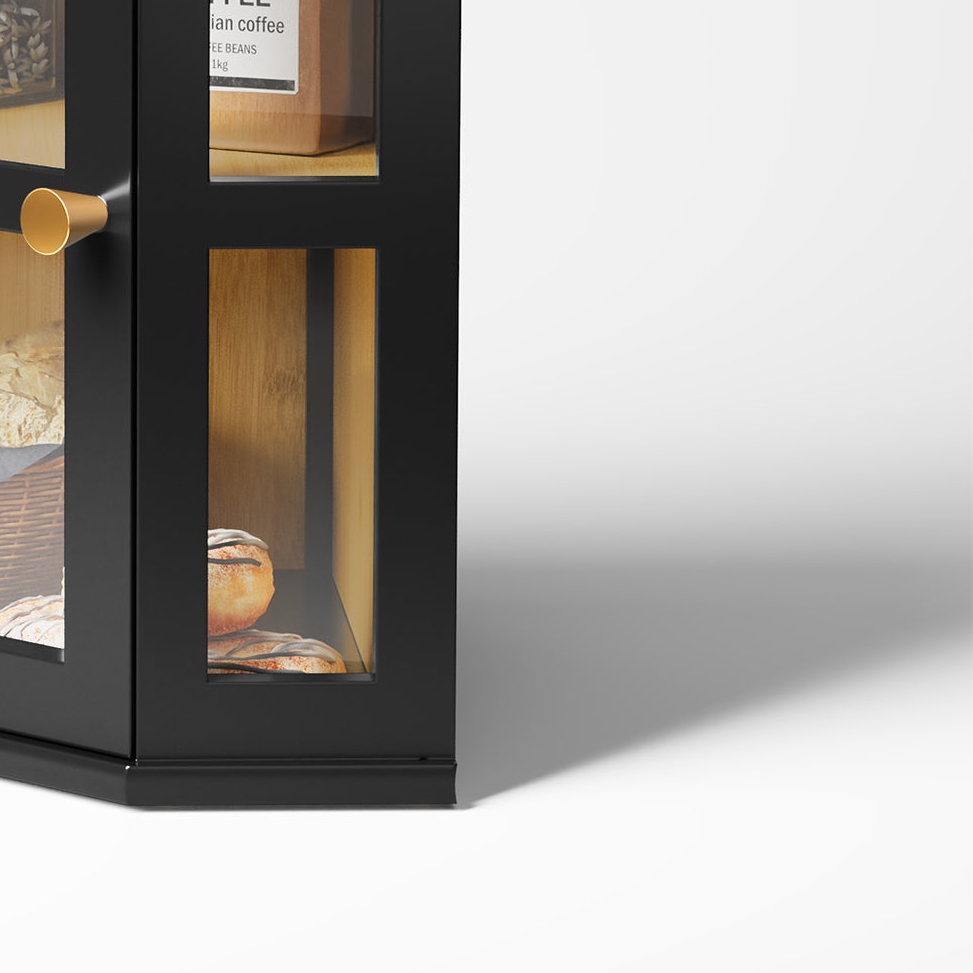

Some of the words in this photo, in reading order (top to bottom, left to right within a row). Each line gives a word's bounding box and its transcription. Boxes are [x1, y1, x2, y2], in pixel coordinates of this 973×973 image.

[238, 15, 285, 34] coffee
[209, 42, 224, 54] EE
[225, 43, 258, 56] BEANS
[211, 59, 229, 72] 1kg
